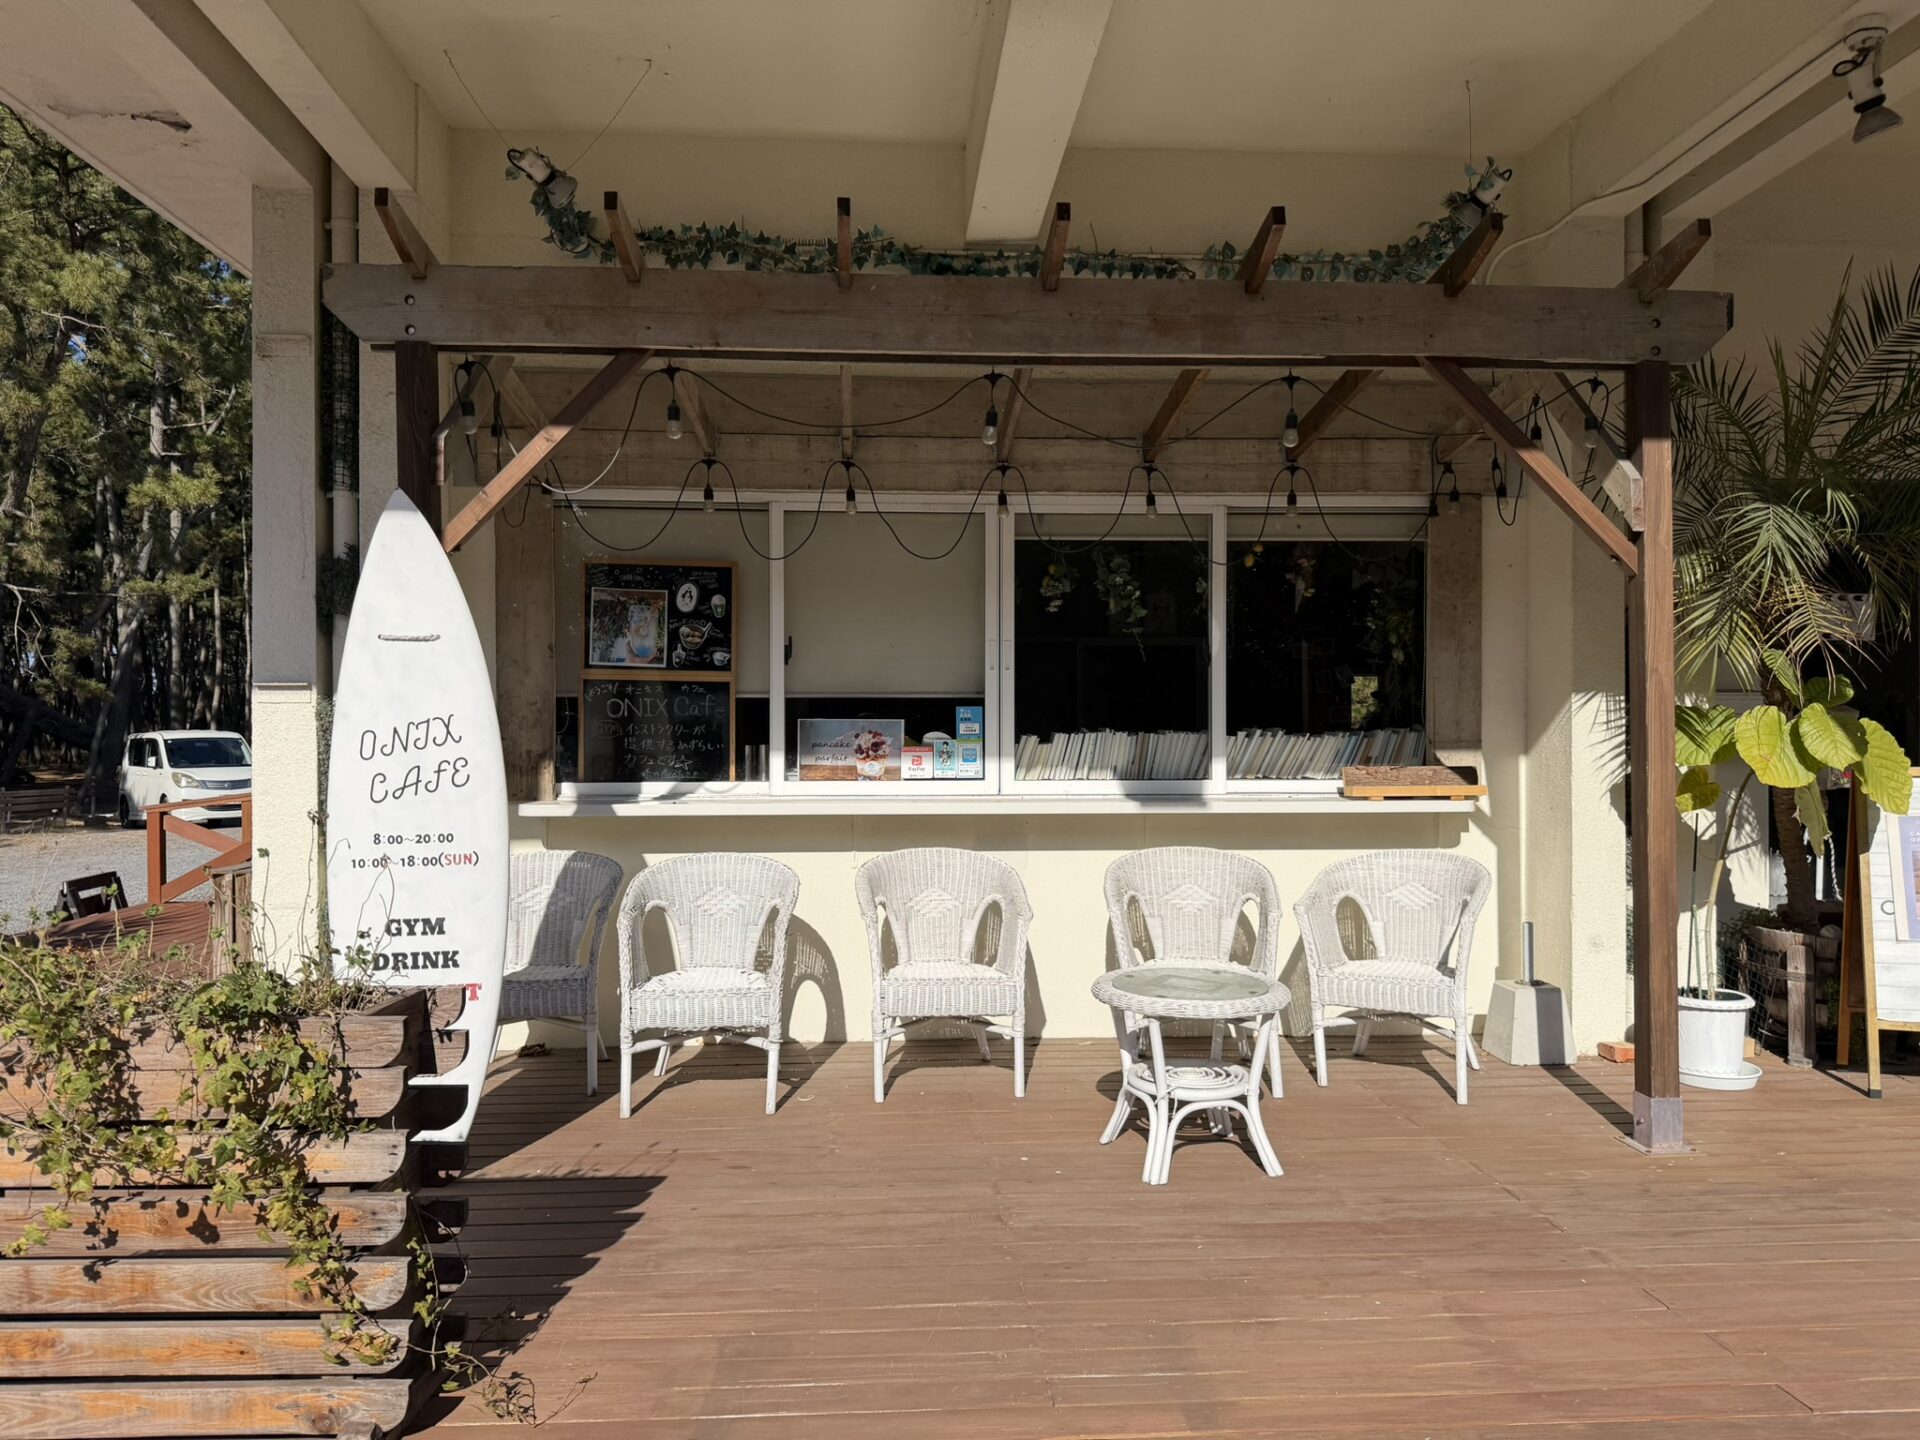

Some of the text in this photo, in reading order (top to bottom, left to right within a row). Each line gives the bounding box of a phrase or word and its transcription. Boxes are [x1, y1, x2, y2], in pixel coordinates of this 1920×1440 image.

[606, 697, 668, 719] ONIX
[360, 713, 463, 761] ONIX
[812, 739, 851, 750] pancake
[815, 754, 848, 764] parfait
[385, 917, 446, 937] GYM
[372, 950, 459, 971] DRINK
